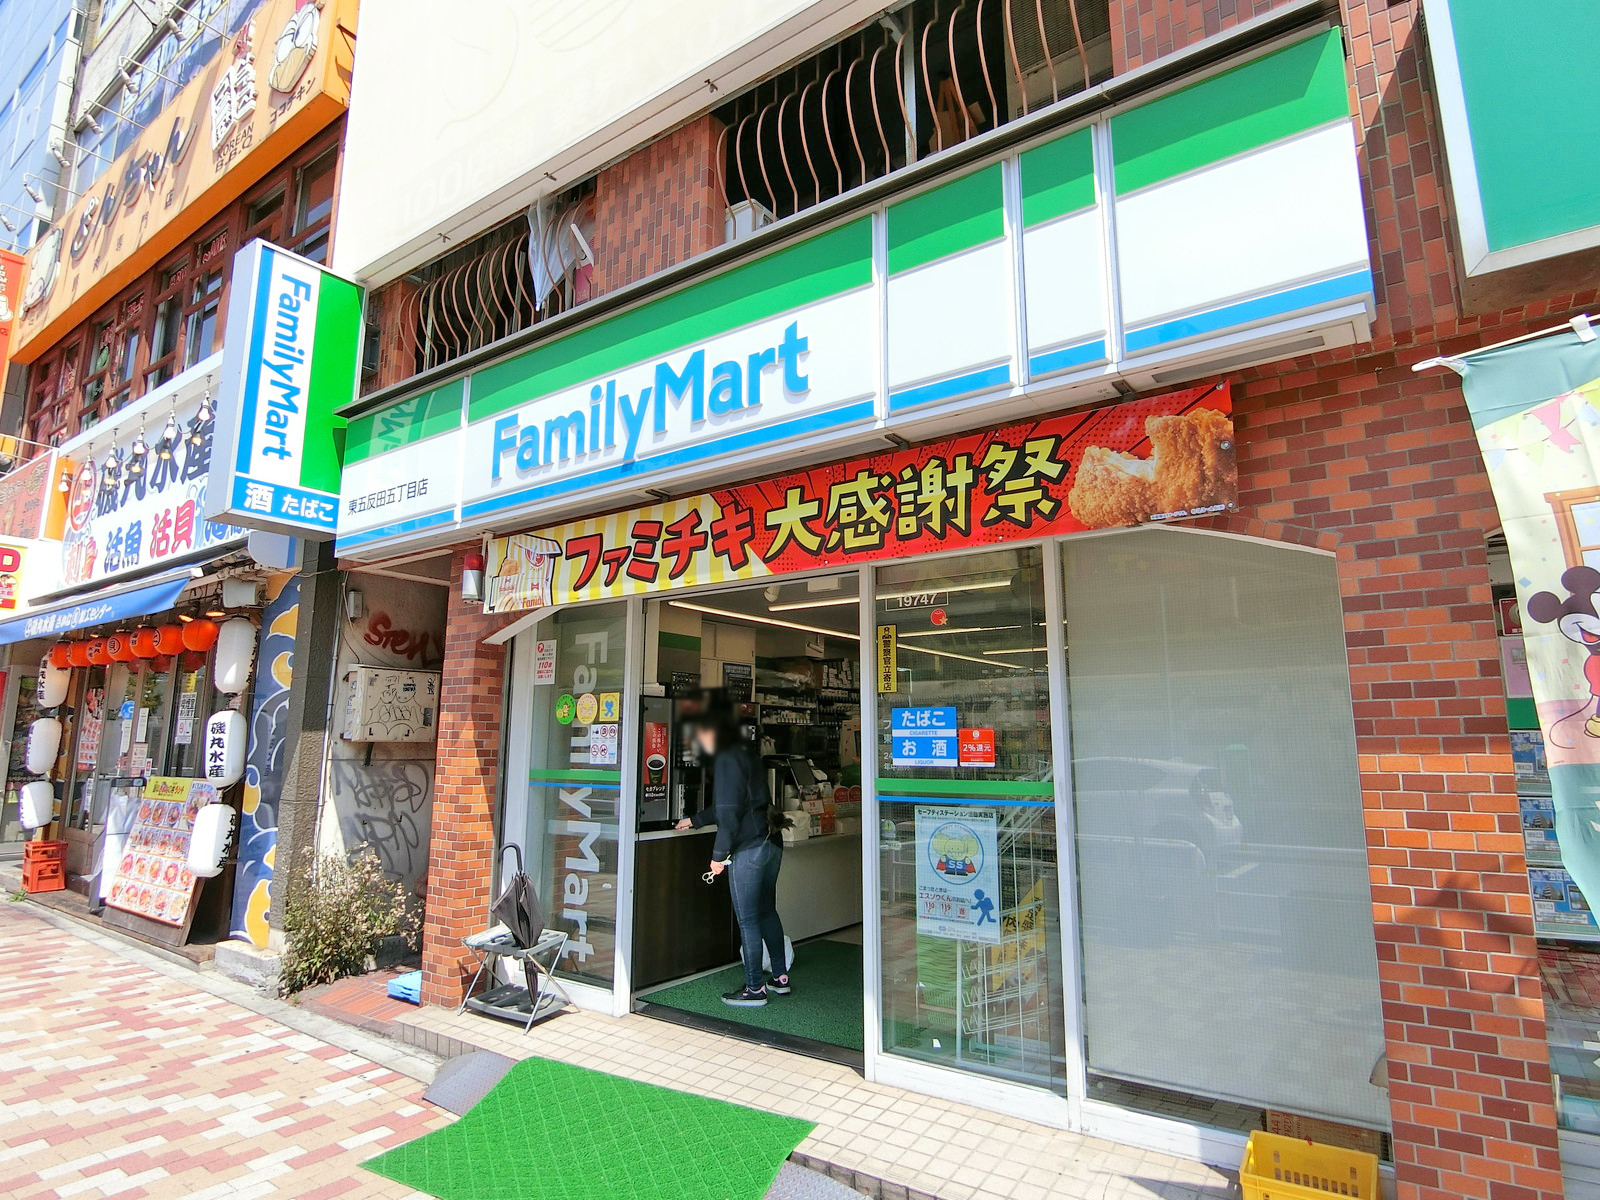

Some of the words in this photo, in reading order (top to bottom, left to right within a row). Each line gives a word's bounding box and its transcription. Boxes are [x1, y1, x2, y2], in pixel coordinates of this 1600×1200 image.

[269, 77, 316, 125] ココチキン
[215, 135, 253, 174] B.B.Q
[217, 122, 254, 160] KOREAN
[262, 273, 311, 460] FamilyMart
[491, 320, 810, 481] FamilyMart
[243, 482, 274, 514] 酒
[280, 493, 334, 523] たばこ
[348, 478, 429, 516] 東五反田五丁目店
[104, 519, 143, 574] 活魚
[150, 499, 196, 559] 活貝
[897, 593, 938, 608] 19747
[882, 639, 892, 691] 警察官立寄店
[901, 710, 946, 727] たばこ
[209, 721, 226, 778] 磯丸水産
[902, 740, 917, 756] お
[931, 740, 947, 757] 酒
[962, 743, 992, 752] 2%還元
[948, 861, 963, 869] SS
